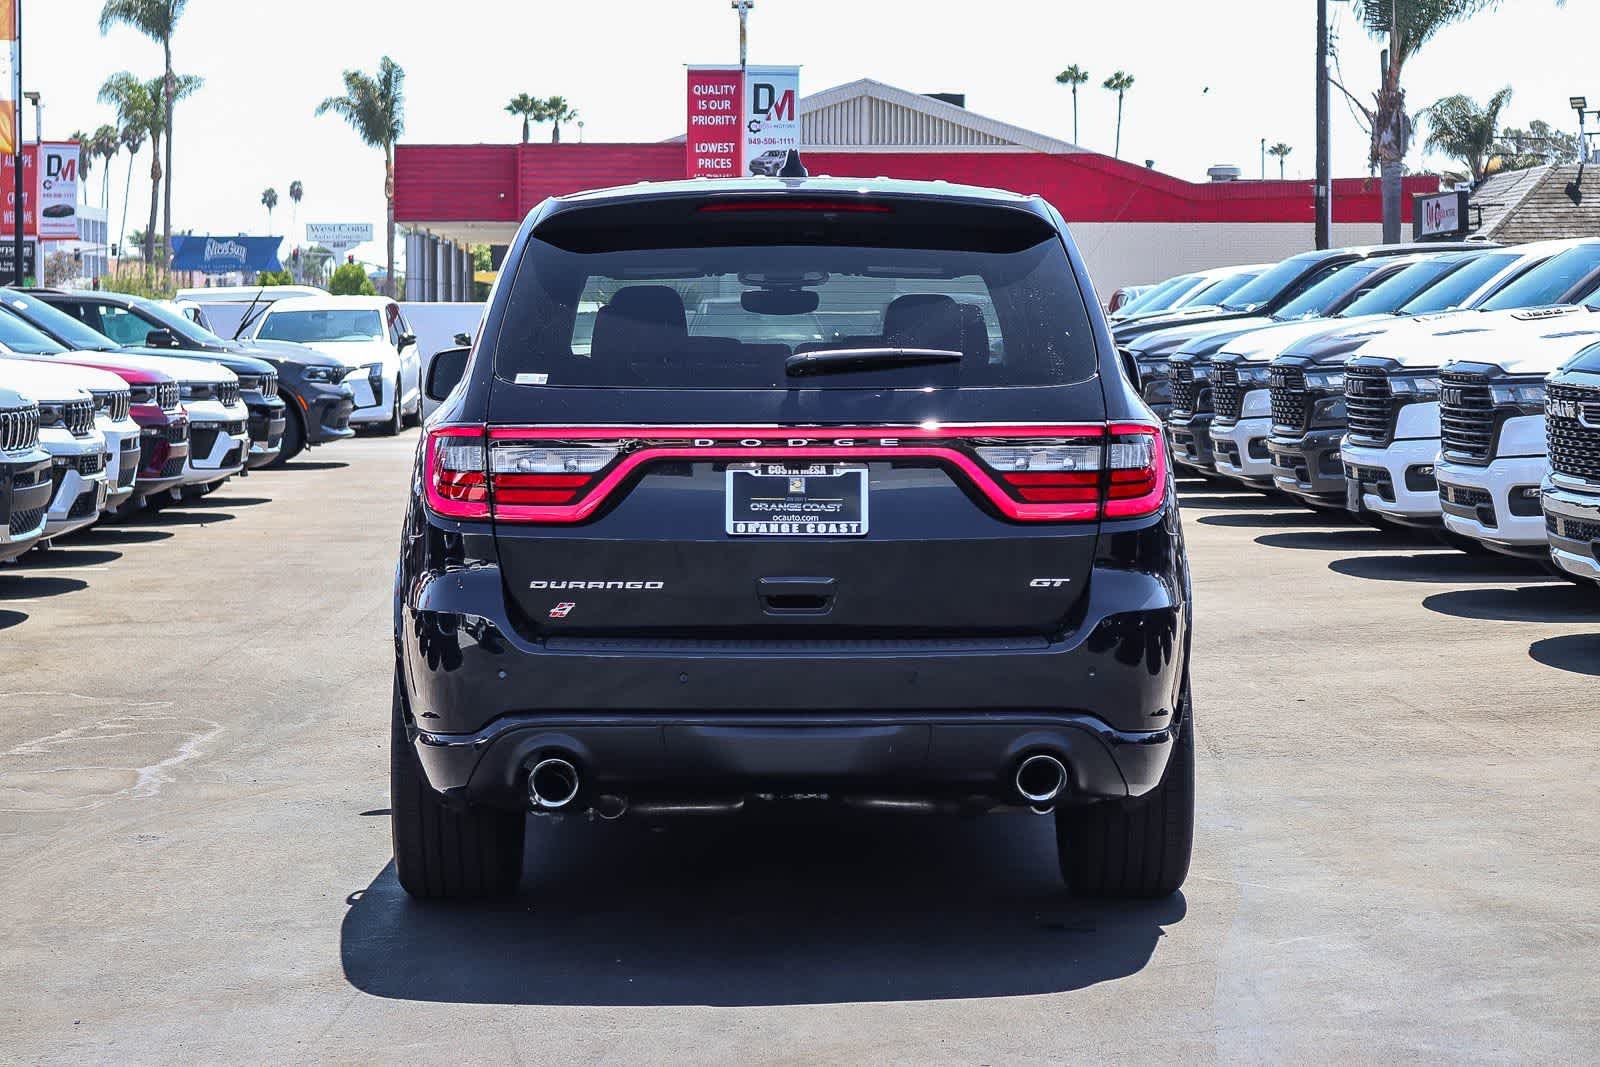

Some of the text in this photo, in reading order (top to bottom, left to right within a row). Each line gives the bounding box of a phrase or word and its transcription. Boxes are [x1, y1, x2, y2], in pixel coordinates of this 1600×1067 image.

[693, 84, 736, 96] QUALITY
[698, 100, 731, 110] IS OUR
[692, 115, 737, 126] PRIORITY
[695, 143, 735, 153] LOWEST
[698, 158, 732, 169] PRICES
[1441, 388, 1463, 405] AM
[694, 438, 900, 447] DODGE
[750, 502, 843, 512] ORANGE COAST
[772, 514, 819, 522] ocauto.com
[736, 523, 859, 533] ORANGE COAST
[529, 580, 665, 590] DURANGO
[1029, 578, 1071, 587] GT
